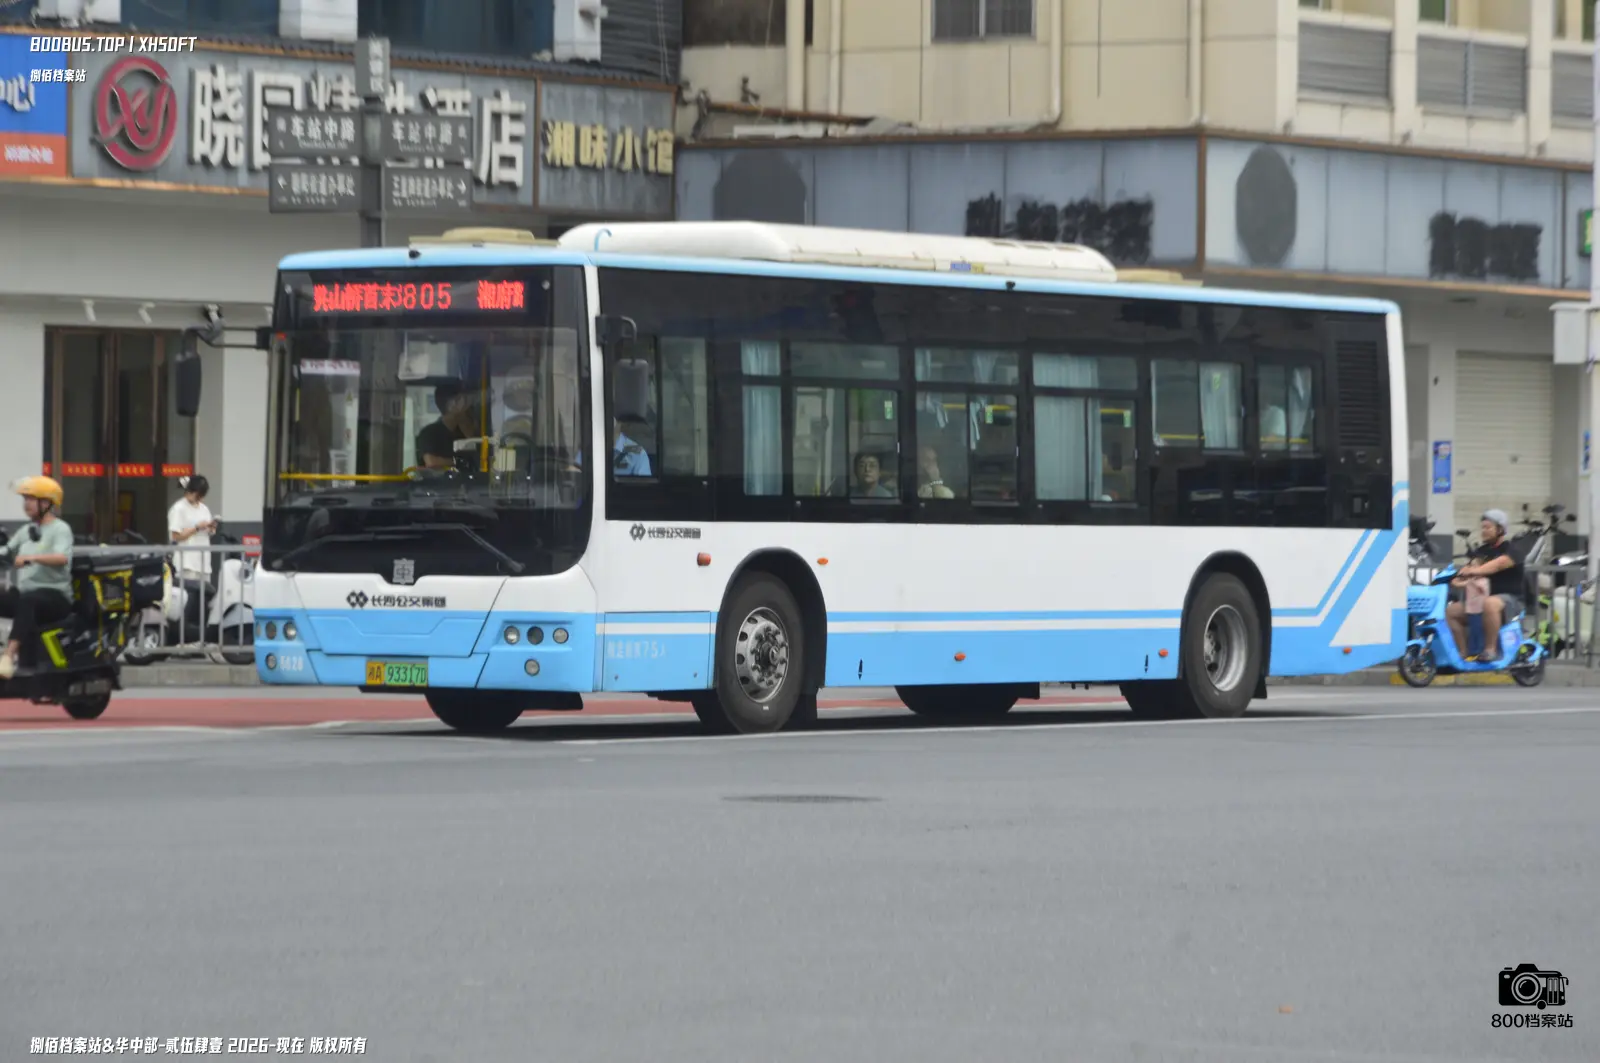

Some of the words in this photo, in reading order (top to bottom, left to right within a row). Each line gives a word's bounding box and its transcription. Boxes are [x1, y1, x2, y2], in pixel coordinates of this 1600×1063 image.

[0, 74, 36, 112] 心
[545, 120, 674, 174] 湘味小馆
[403, 282, 451, 310] 805
